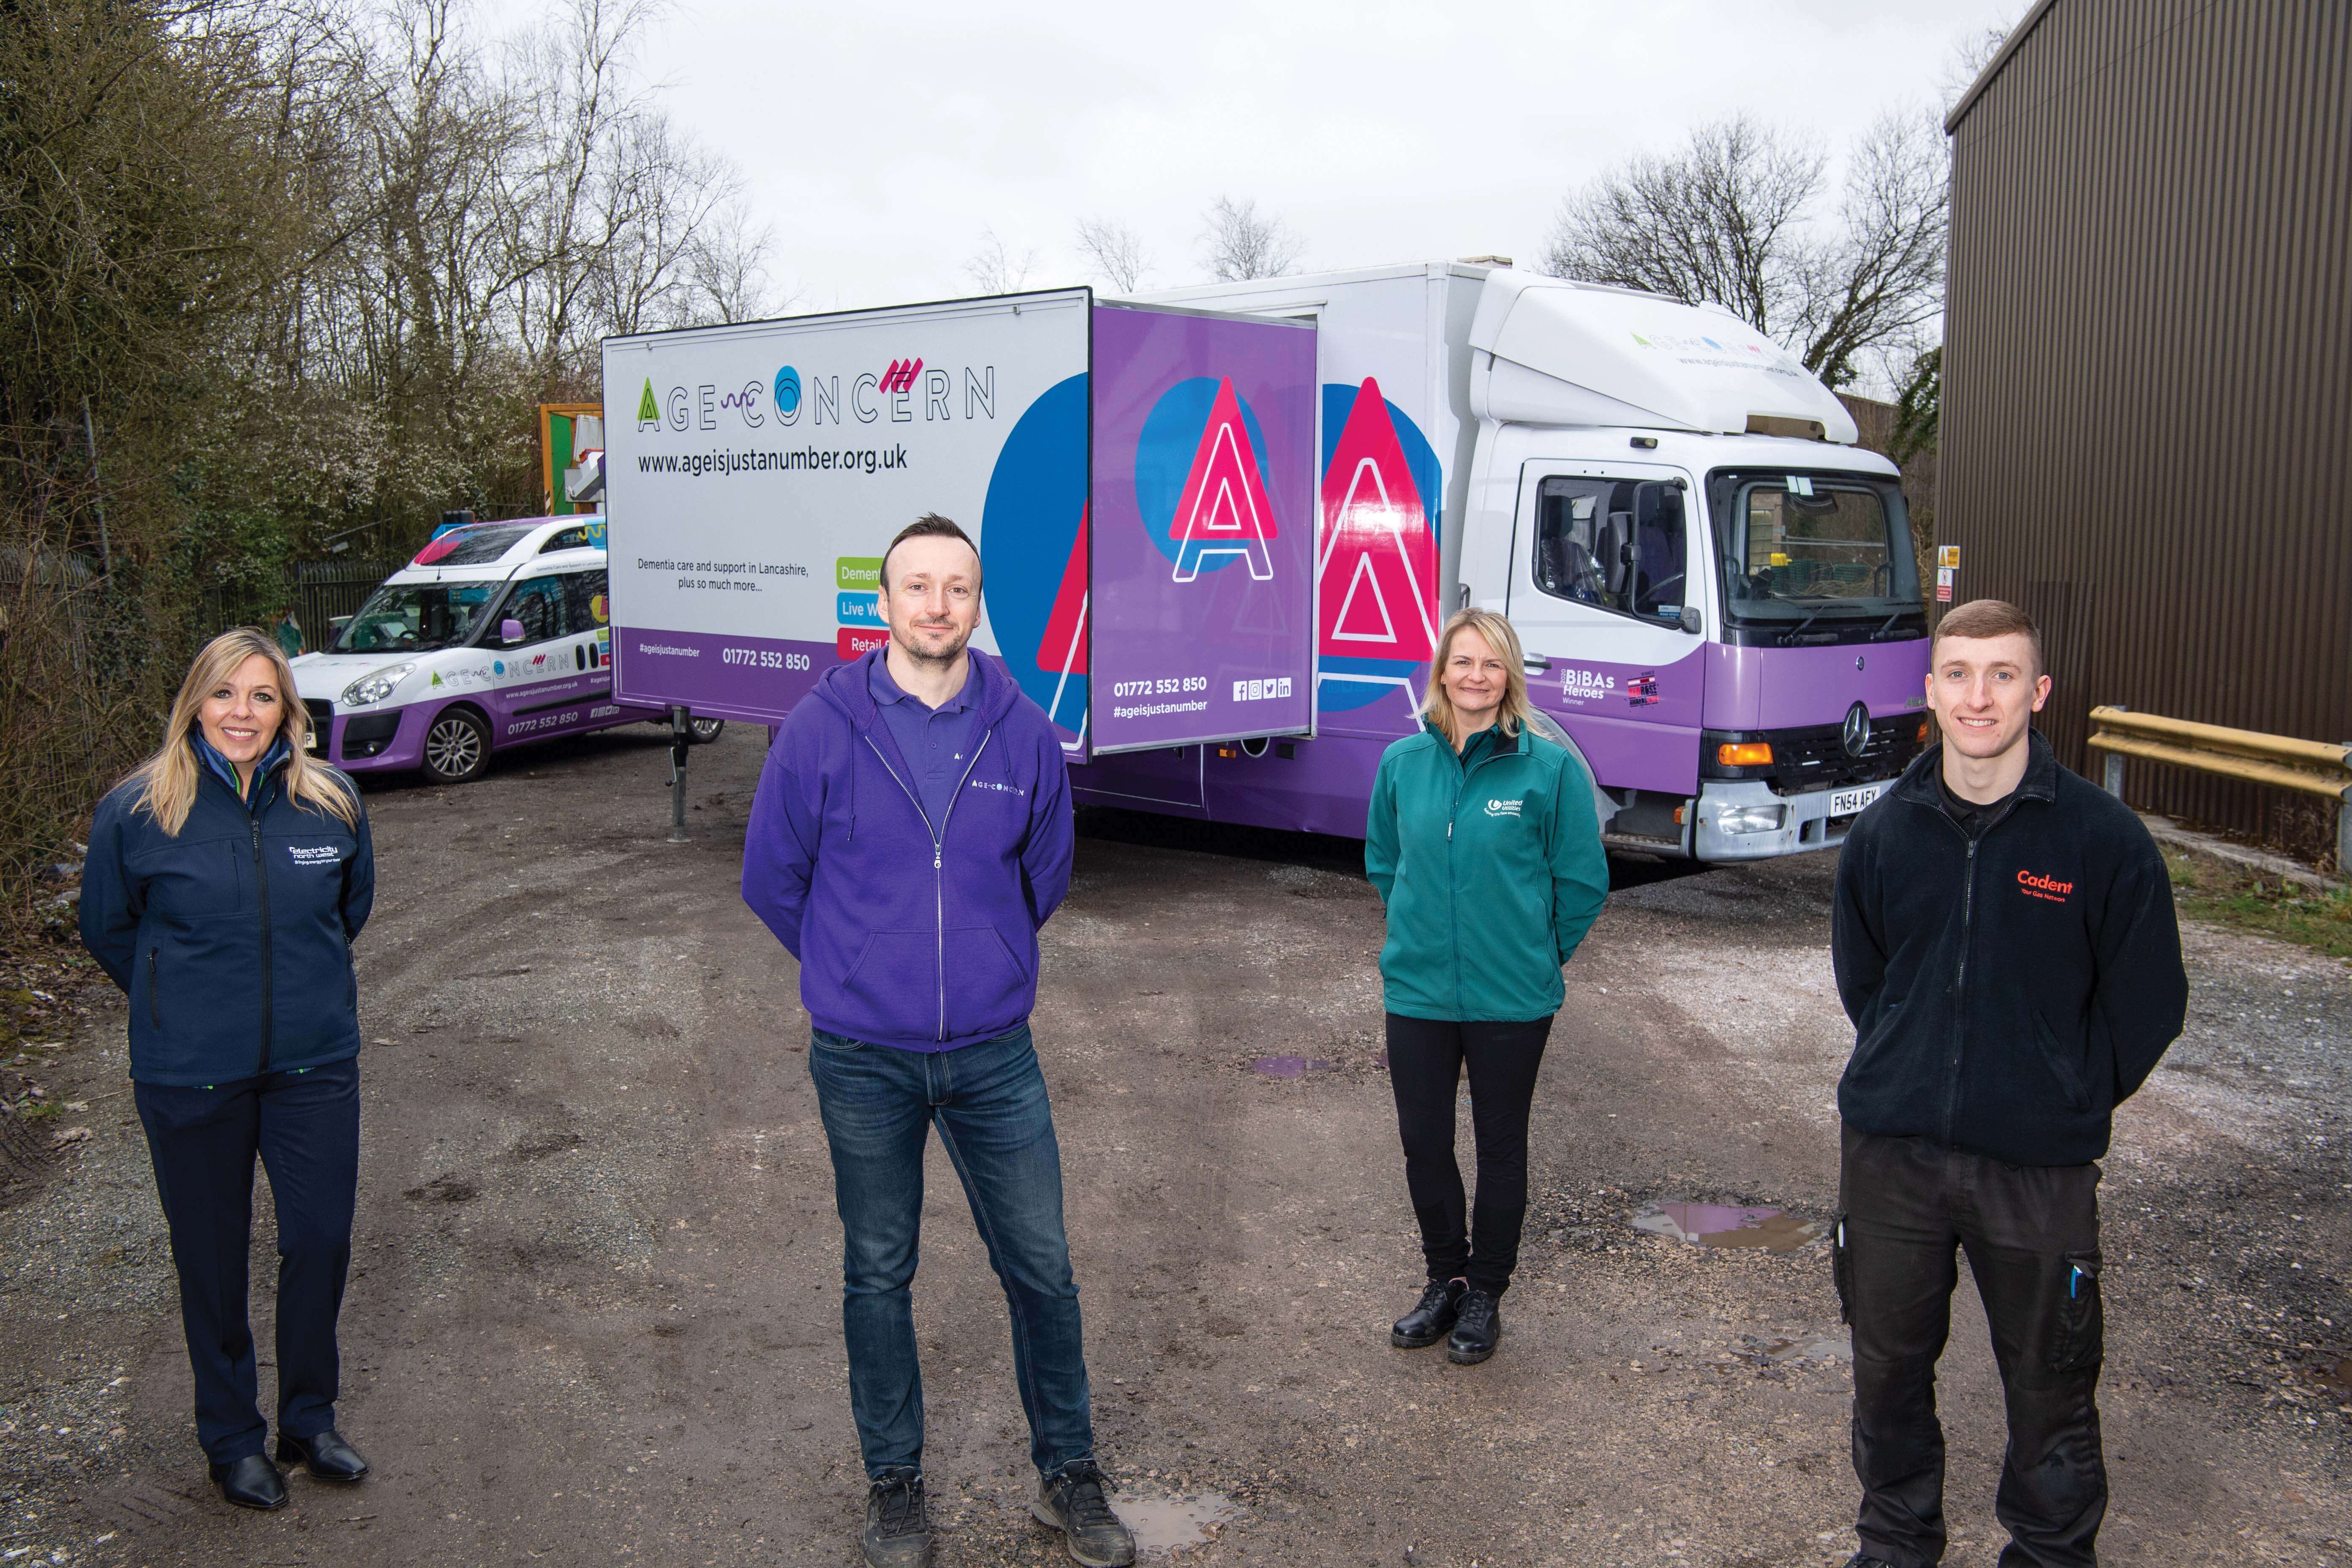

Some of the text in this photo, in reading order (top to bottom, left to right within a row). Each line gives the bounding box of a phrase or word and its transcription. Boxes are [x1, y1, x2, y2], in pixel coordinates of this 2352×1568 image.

[638, 366, 994, 432] AGE CONCERN
[638, 443, 907, 476] www.ageisjustanumber.org.uk
[638, 558, 808, 577] Dementia care and support in Lancashire,
[678, 577, 762, 591] plus so much more...
[842, 602, 864, 616] Live
[852, 637, 881, 652] Retail
[640, 643, 810, 671] #ageisjustanumber 01772 552 850
[431, 653, 569, 689] AGE CONCERN
[506, 681, 578, 698] www.ageisjustanumber.org.uk
[1114, 676, 1207, 697] 01772 552 850
[1563, 685, 1604, 699] Heroes
[1114, 700, 1207, 718] #ageisjustanumber
[1563, 697, 1584, 705] Winner
[508, 711, 578, 735] 01772 552 850
[972, 780, 988, 789] AGE
[1835, 789, 1876, 812] FN54 AFY
[292, 846, 338, 854] electricity
[2017, 870, 2073, 894] Cadent
[2044, 893, 2066, 902] Network
